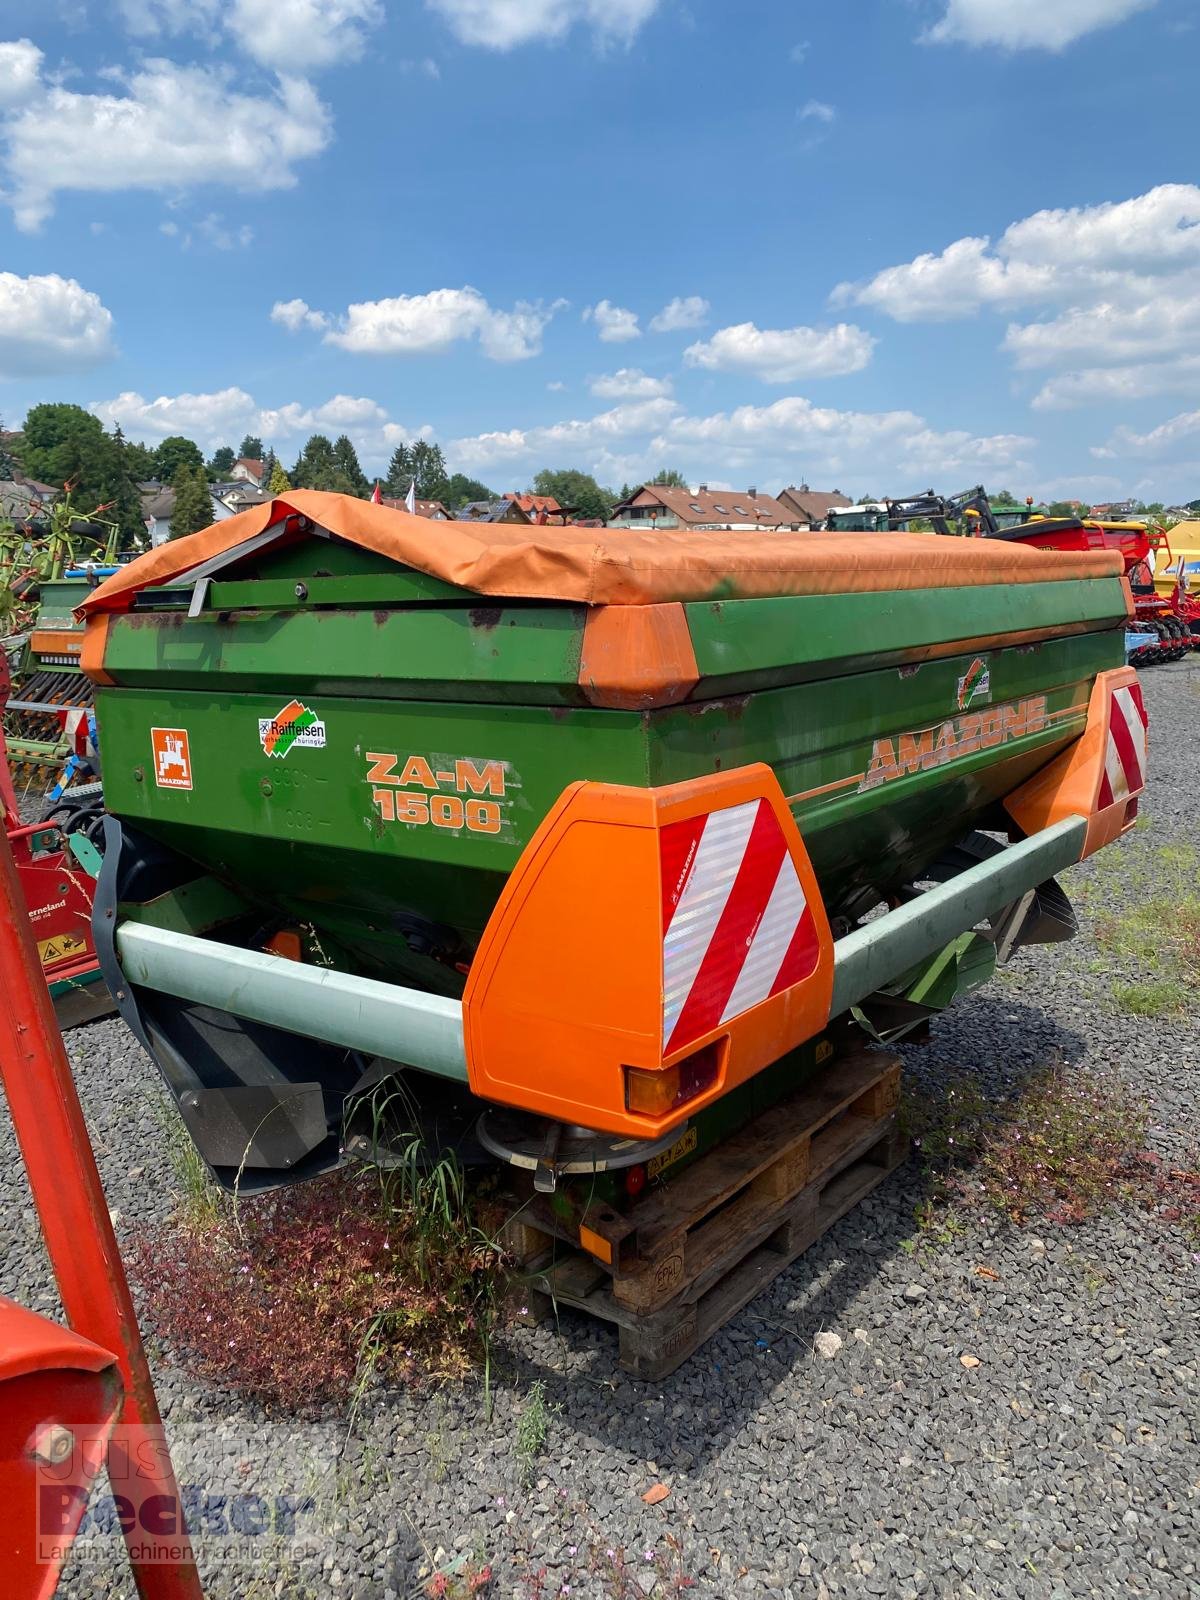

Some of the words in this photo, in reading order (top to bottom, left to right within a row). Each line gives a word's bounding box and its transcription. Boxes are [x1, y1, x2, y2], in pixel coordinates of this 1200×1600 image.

[270, 720, 325, 738] Raiffeisen
[857, 696, 1046, 793] AMAZONE
[365, 752, 506, 797] ZA-M
[373, 788, 501, 834] 1500
[676, 839, 697, 892] AMAZONE
[28, 899, 67, 918] erneland
